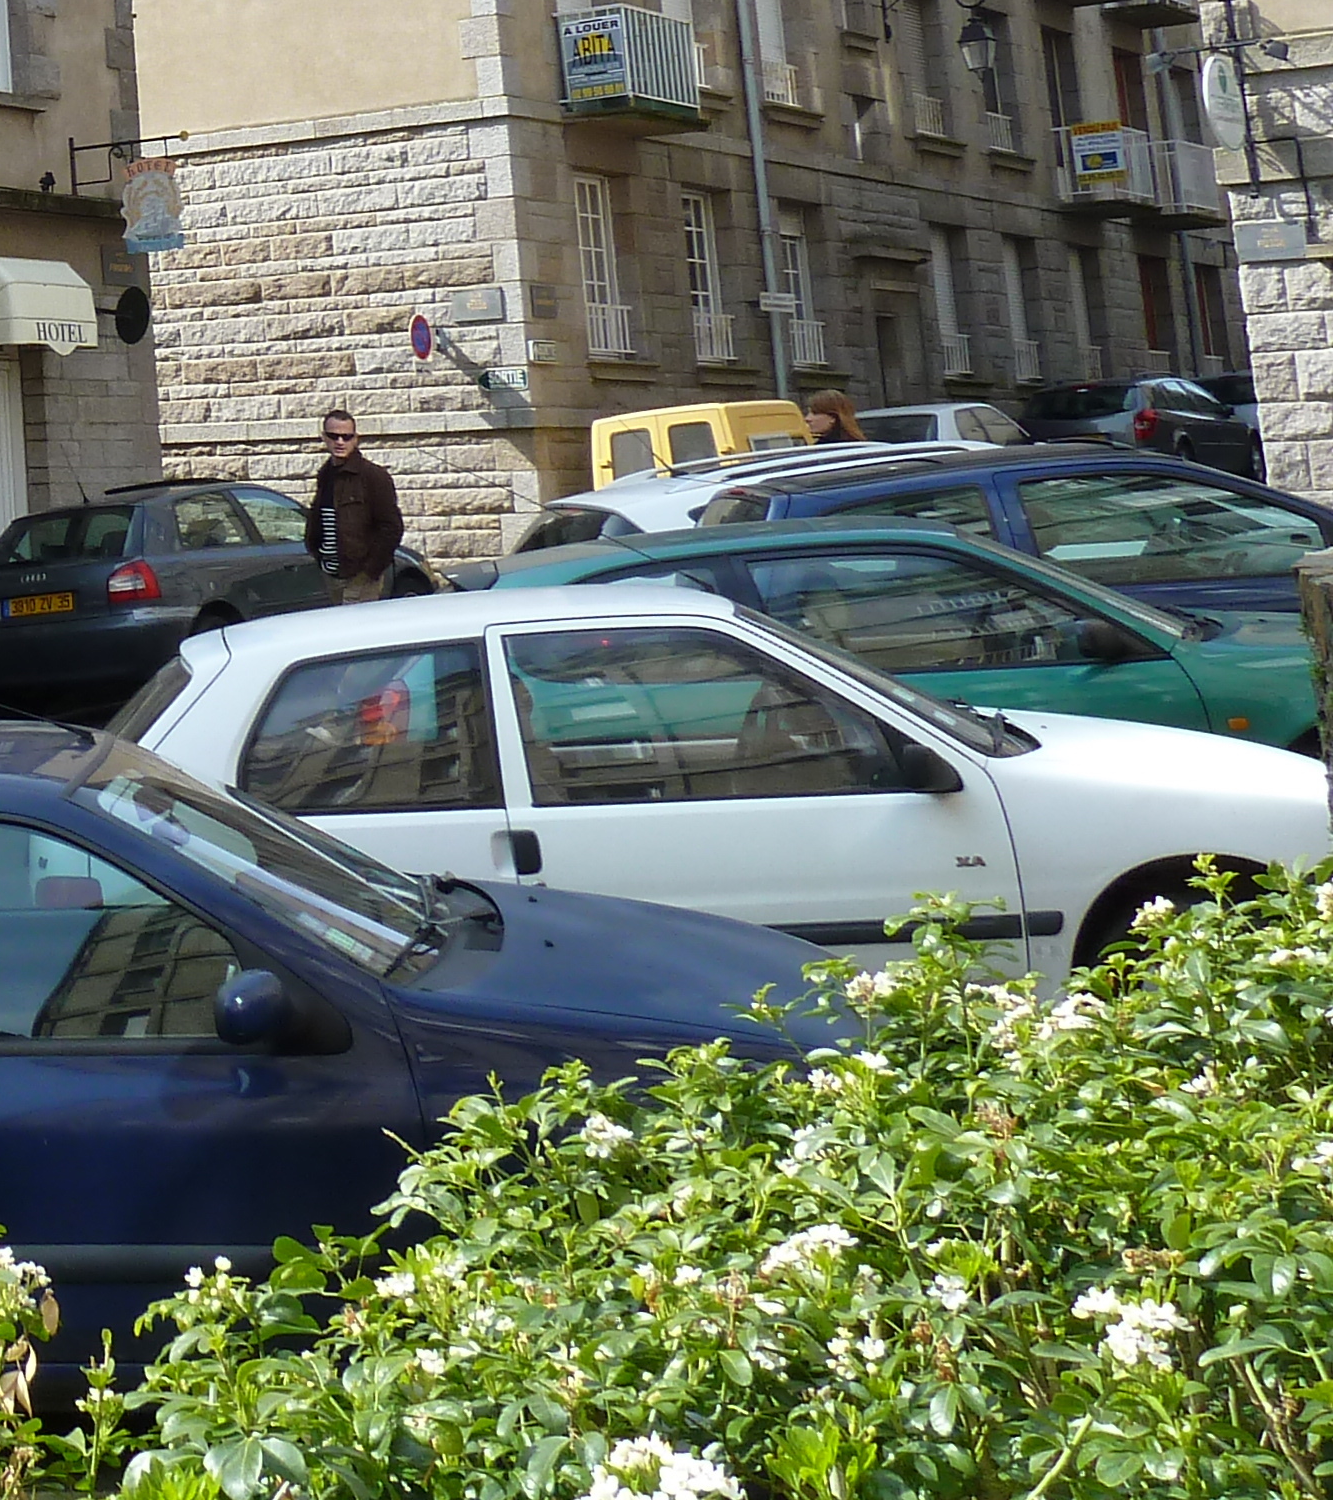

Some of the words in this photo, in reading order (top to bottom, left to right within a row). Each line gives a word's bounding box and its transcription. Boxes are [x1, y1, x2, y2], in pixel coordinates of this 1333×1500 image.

[564, 28, 572, 36] A
[575, 20, 619, 33] LOUER
[573, 33, 617, 67] ABITA
[36, 322, 87, 343] HOTEL
[488, 370, 524, 384] SORTIE
[58, 595, 70, 608] 35
